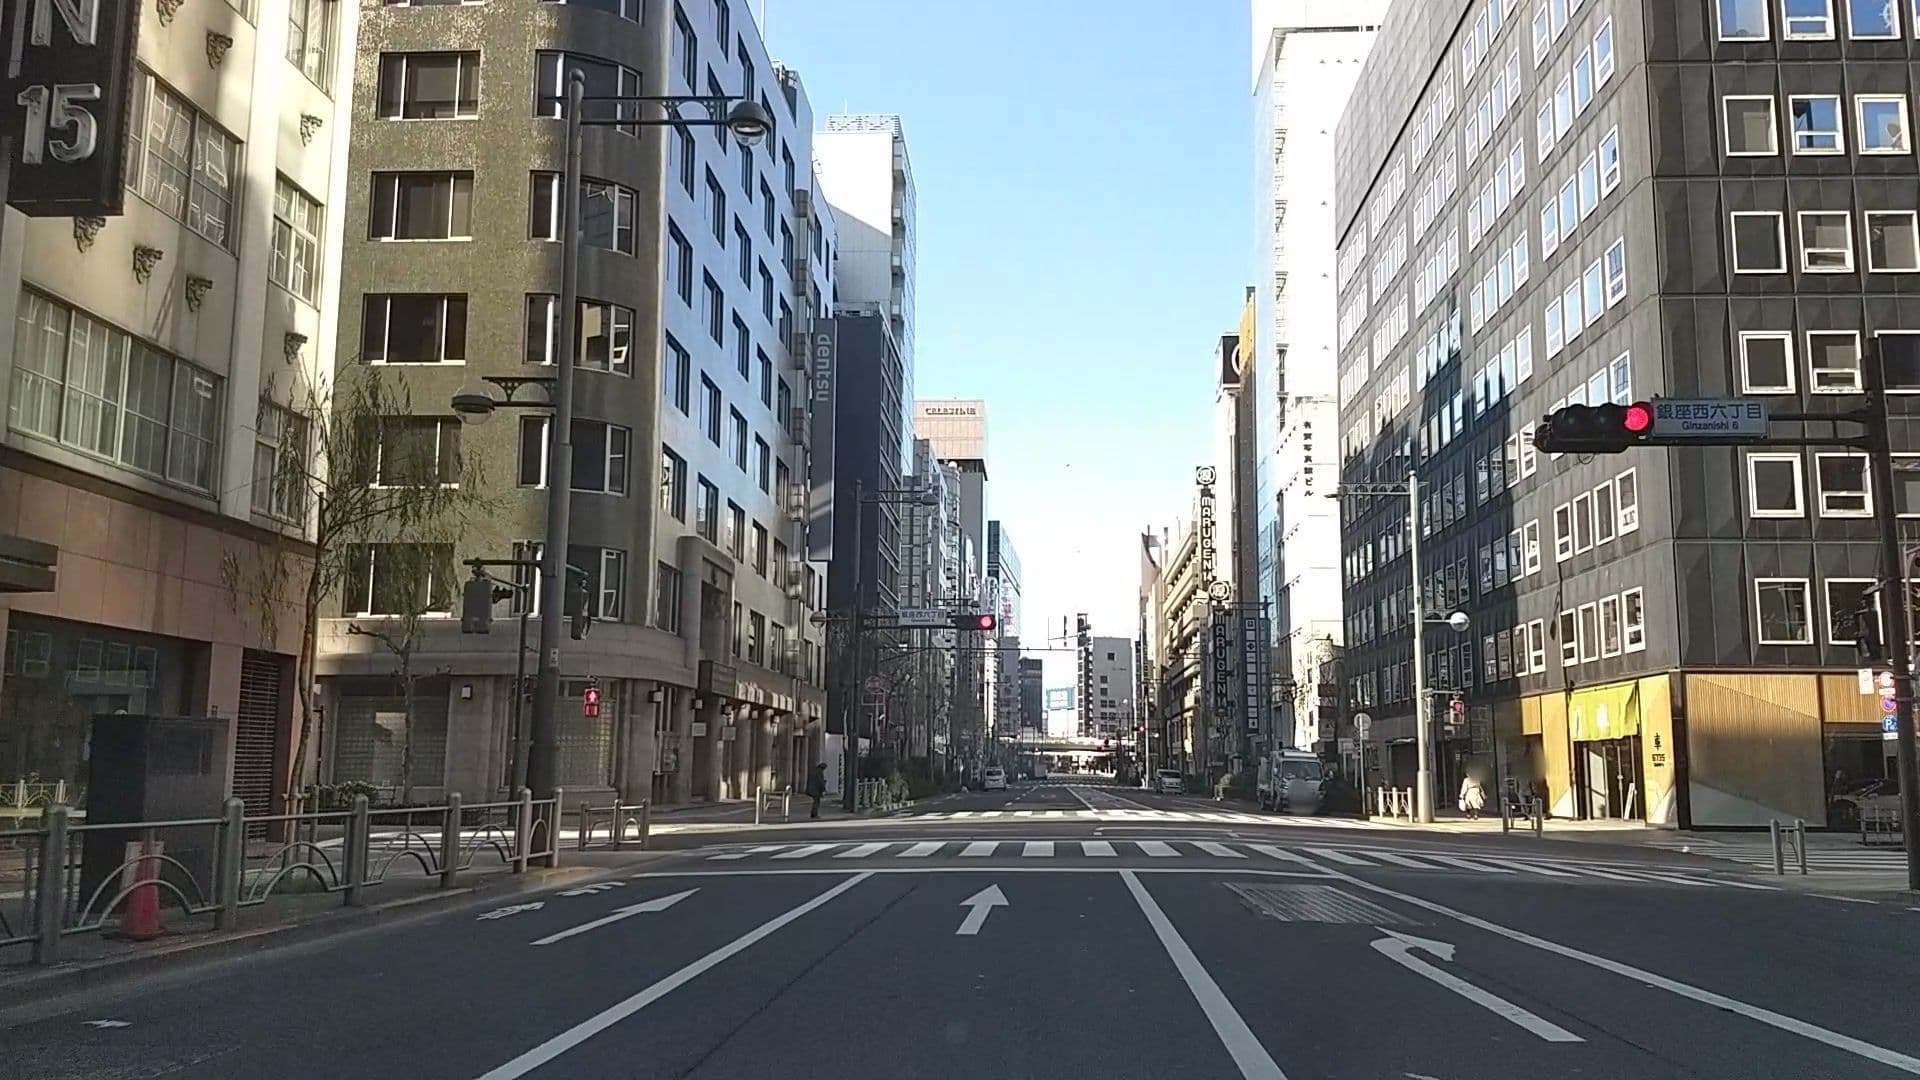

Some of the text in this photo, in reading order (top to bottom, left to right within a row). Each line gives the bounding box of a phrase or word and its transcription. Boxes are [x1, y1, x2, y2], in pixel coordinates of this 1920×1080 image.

[17, 83, 101, 165] 15
[816, 334, 832, 402] dentsu
[1656, 403, 1762, 419] 銀座西六丁目
[1681, 420, 1739, 430] Ginzanishi 6
[1201, 496, 1212, 570] MARUGEN
[1215, 614, 1226, 695] MARUGEN
